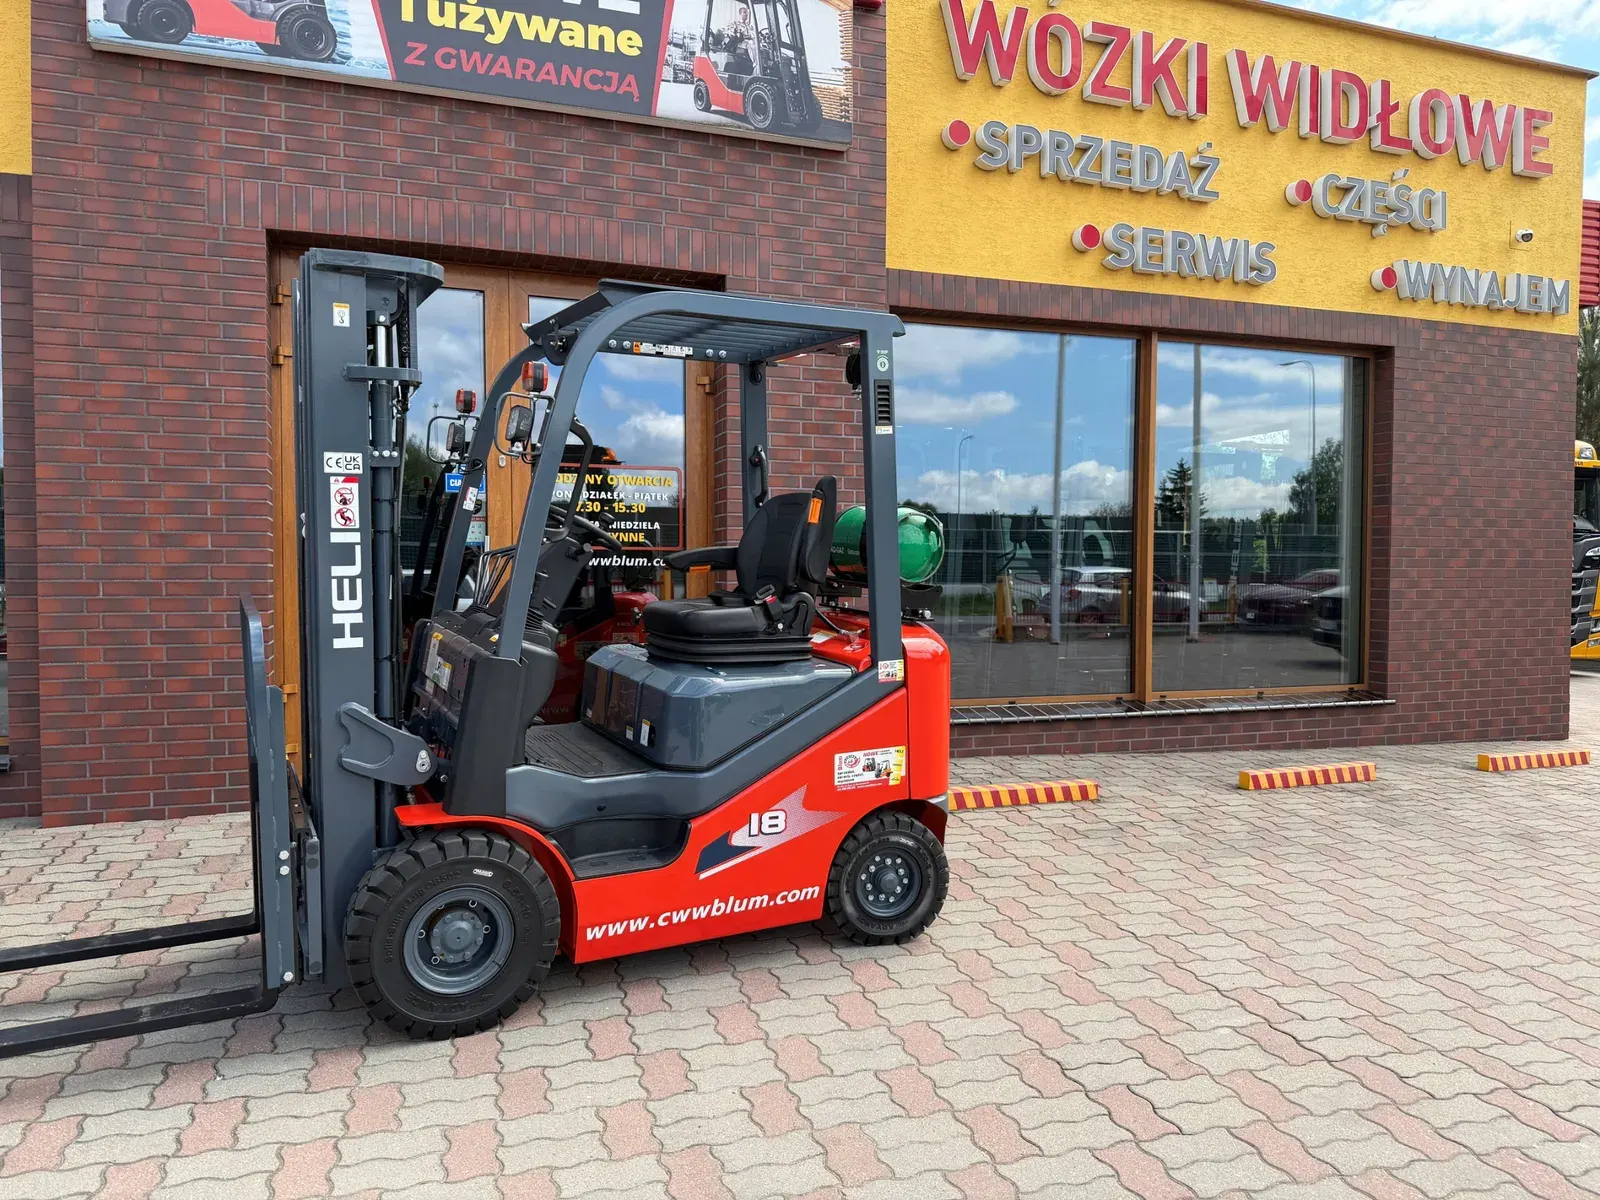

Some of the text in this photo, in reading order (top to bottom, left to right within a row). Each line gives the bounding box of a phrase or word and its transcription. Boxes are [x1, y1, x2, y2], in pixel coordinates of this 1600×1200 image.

[427, 0, 643, 57] używane
[404, 41, 640, 102] Z GWARANCJĄ
[1226, 48, 1553, 178] WIDŁOWE
[975, 121, 1220, 203] SPRZEDAŻ
[1312, 168, 1447, 237] CZĘŚCI
[1102, 222, 1277, 286] SERWIS
[1395, 259, 1570, 316] WYNAJEM
[607, 474, 673, 486] OTWARCIA
[612, 502, 646, 513] 15.30
[634, 492, 669, 502] PIĄTEK
[329, 531, 364, 649] HELI
[749, 810, 787, 837] 18
[586, 885, 820, 941] www.cwwblum.com
